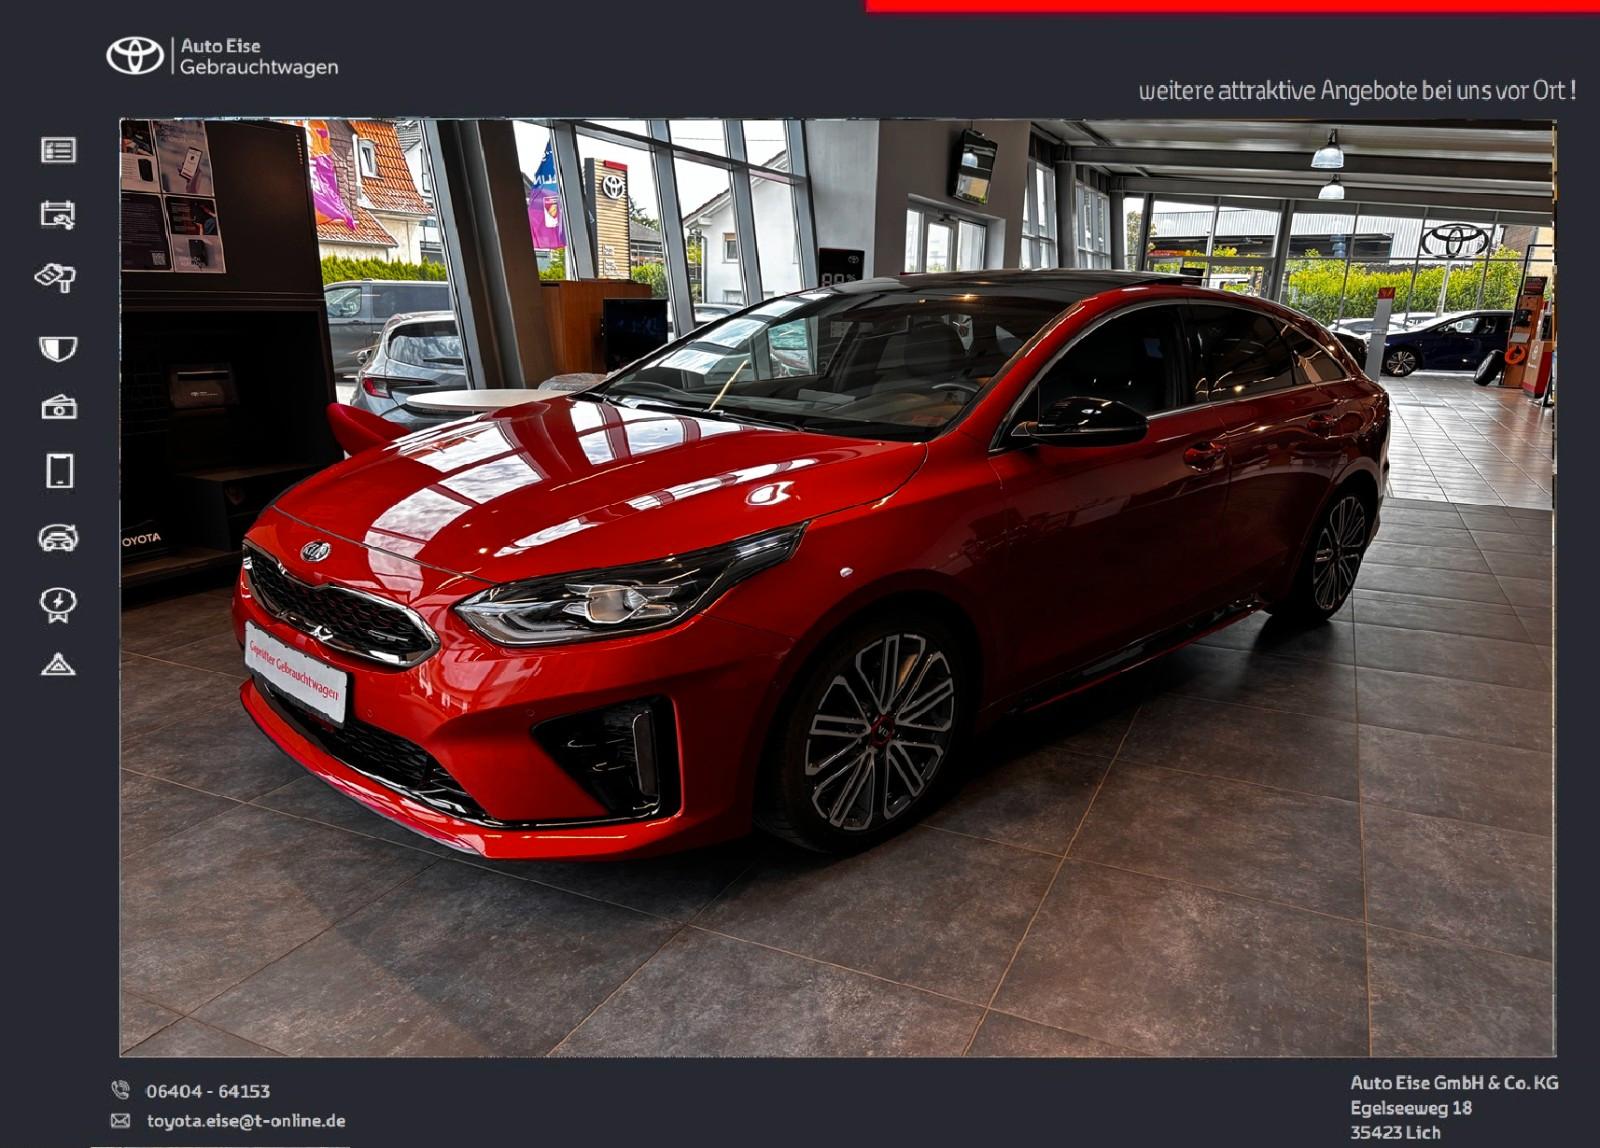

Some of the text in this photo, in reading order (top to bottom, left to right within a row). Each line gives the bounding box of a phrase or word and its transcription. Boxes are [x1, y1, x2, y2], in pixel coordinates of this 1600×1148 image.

[121, 532, 162, 547] OYOTA
[249, 640, 339, 701] Geprüfter Gebrauchtwagen
